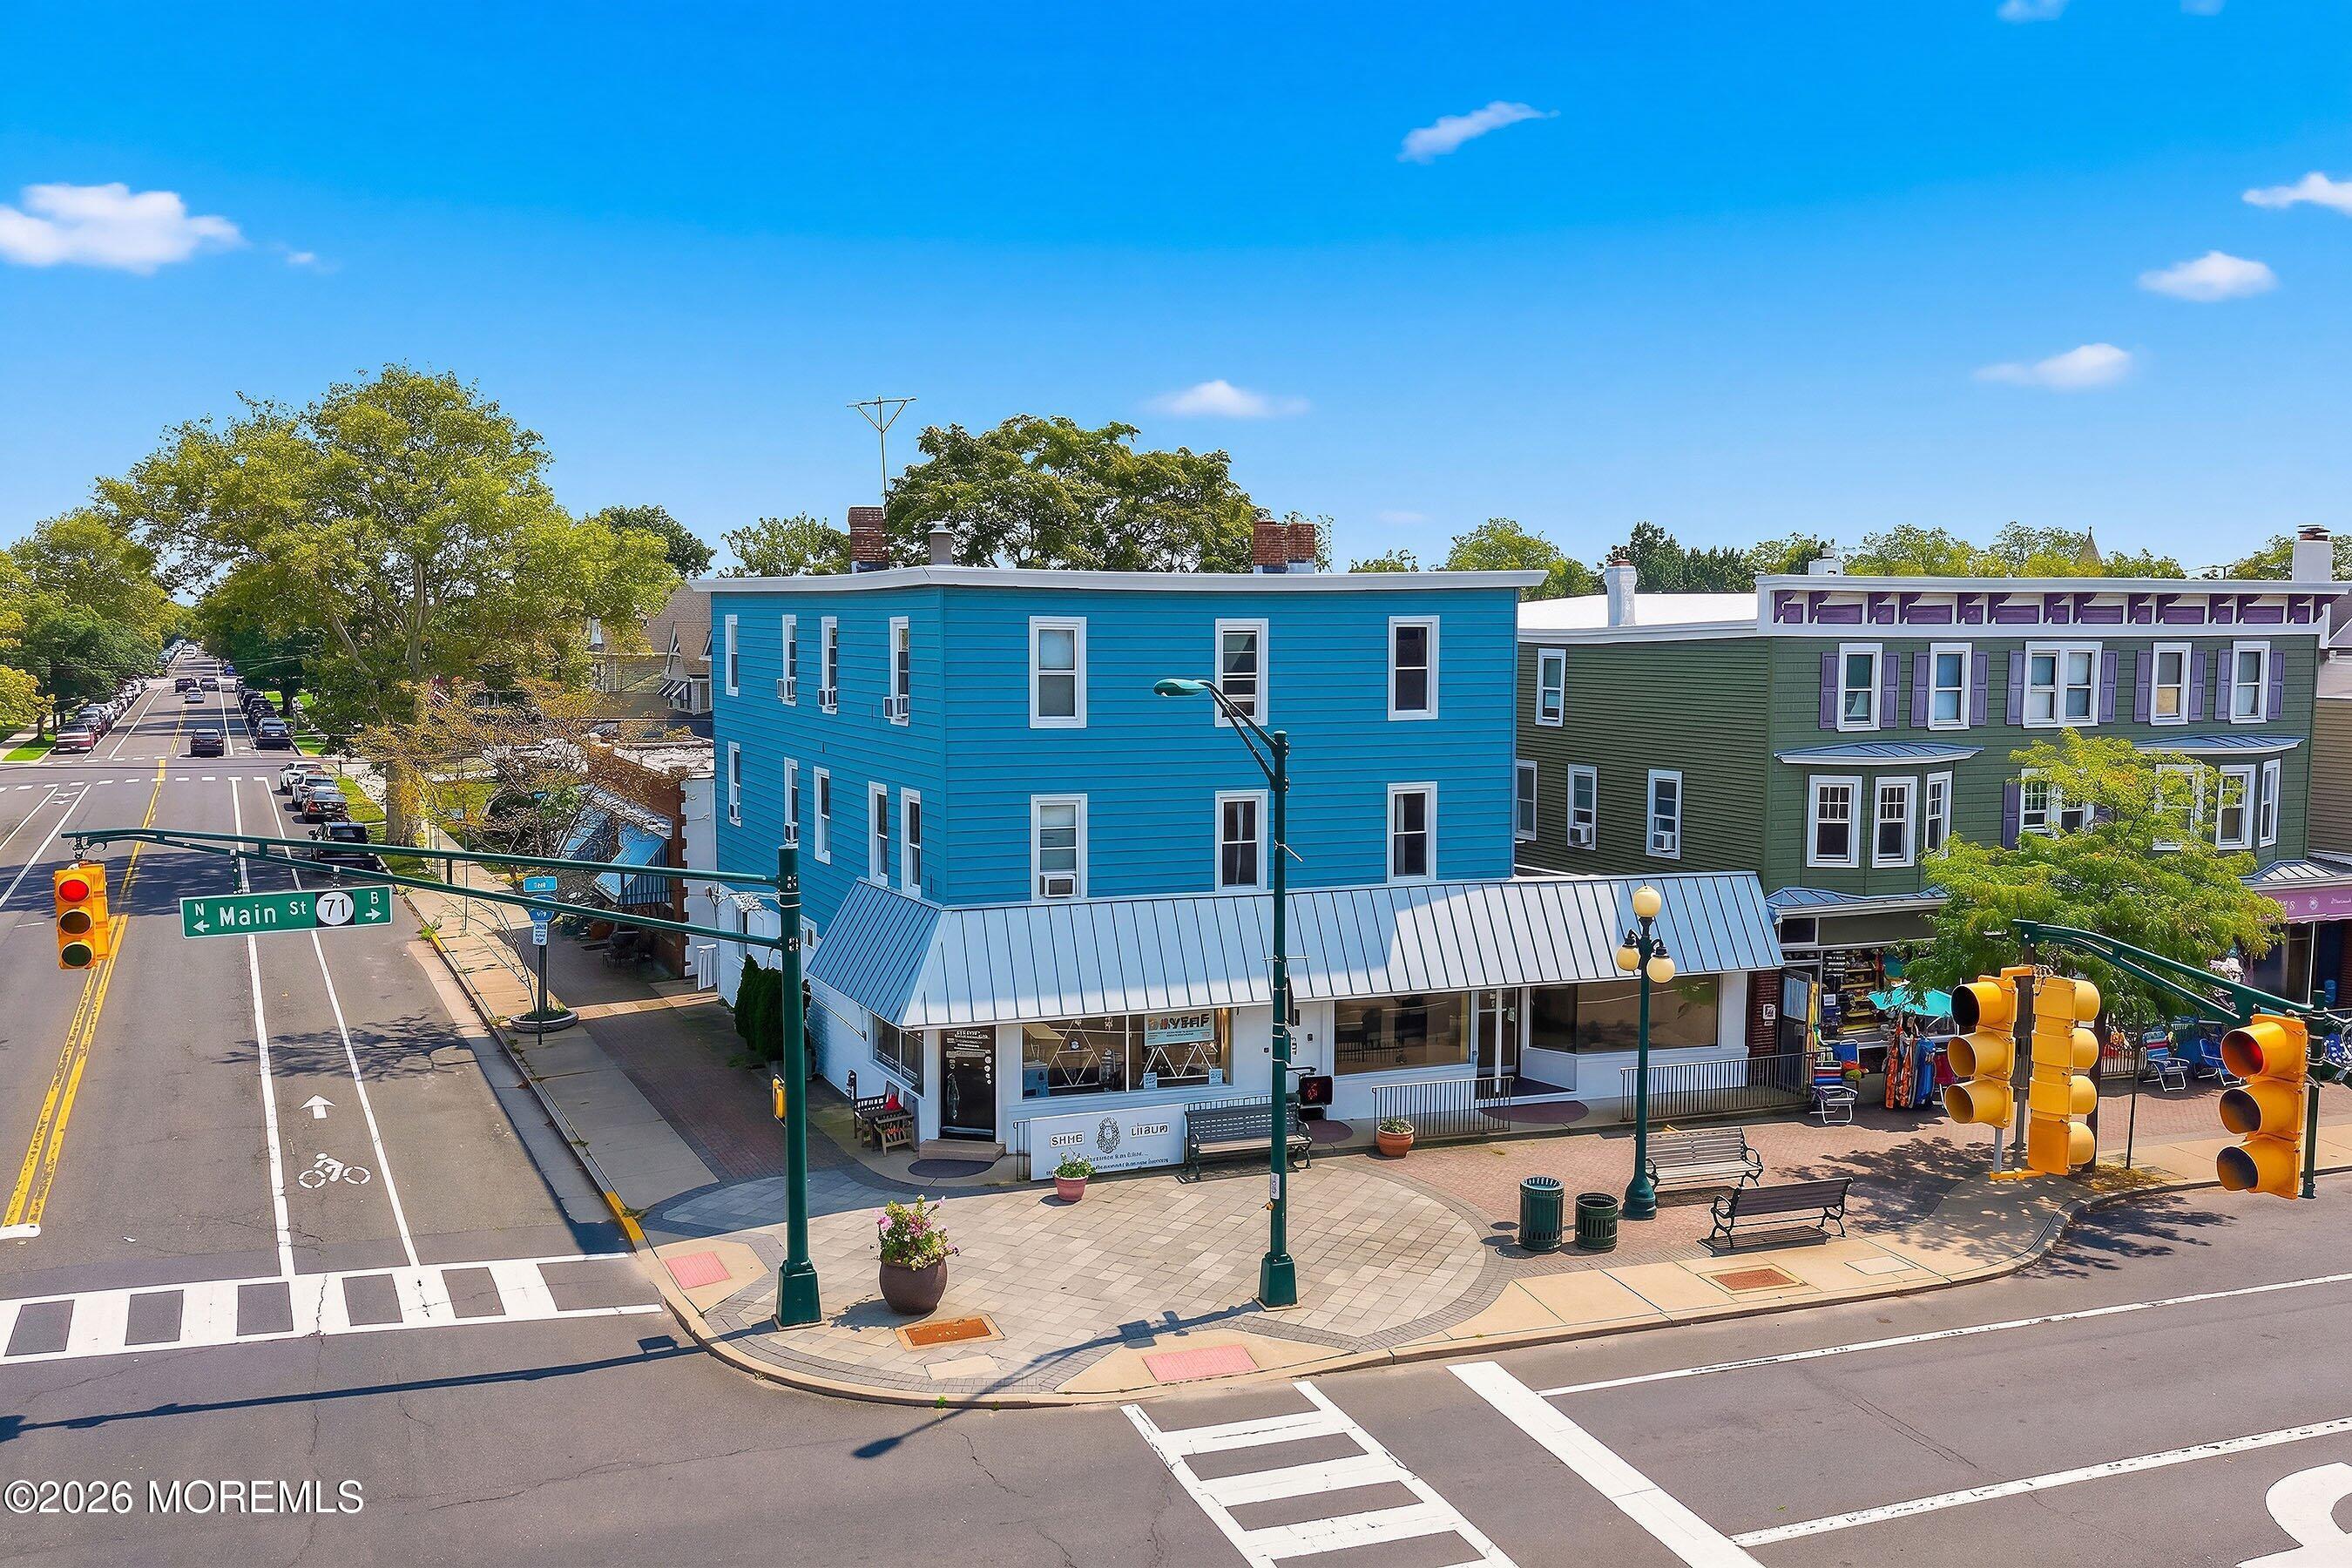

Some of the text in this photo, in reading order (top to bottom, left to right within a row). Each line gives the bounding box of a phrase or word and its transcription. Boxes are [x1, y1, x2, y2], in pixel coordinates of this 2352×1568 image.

[194, 891, 379, 927] N Main St 71 B
